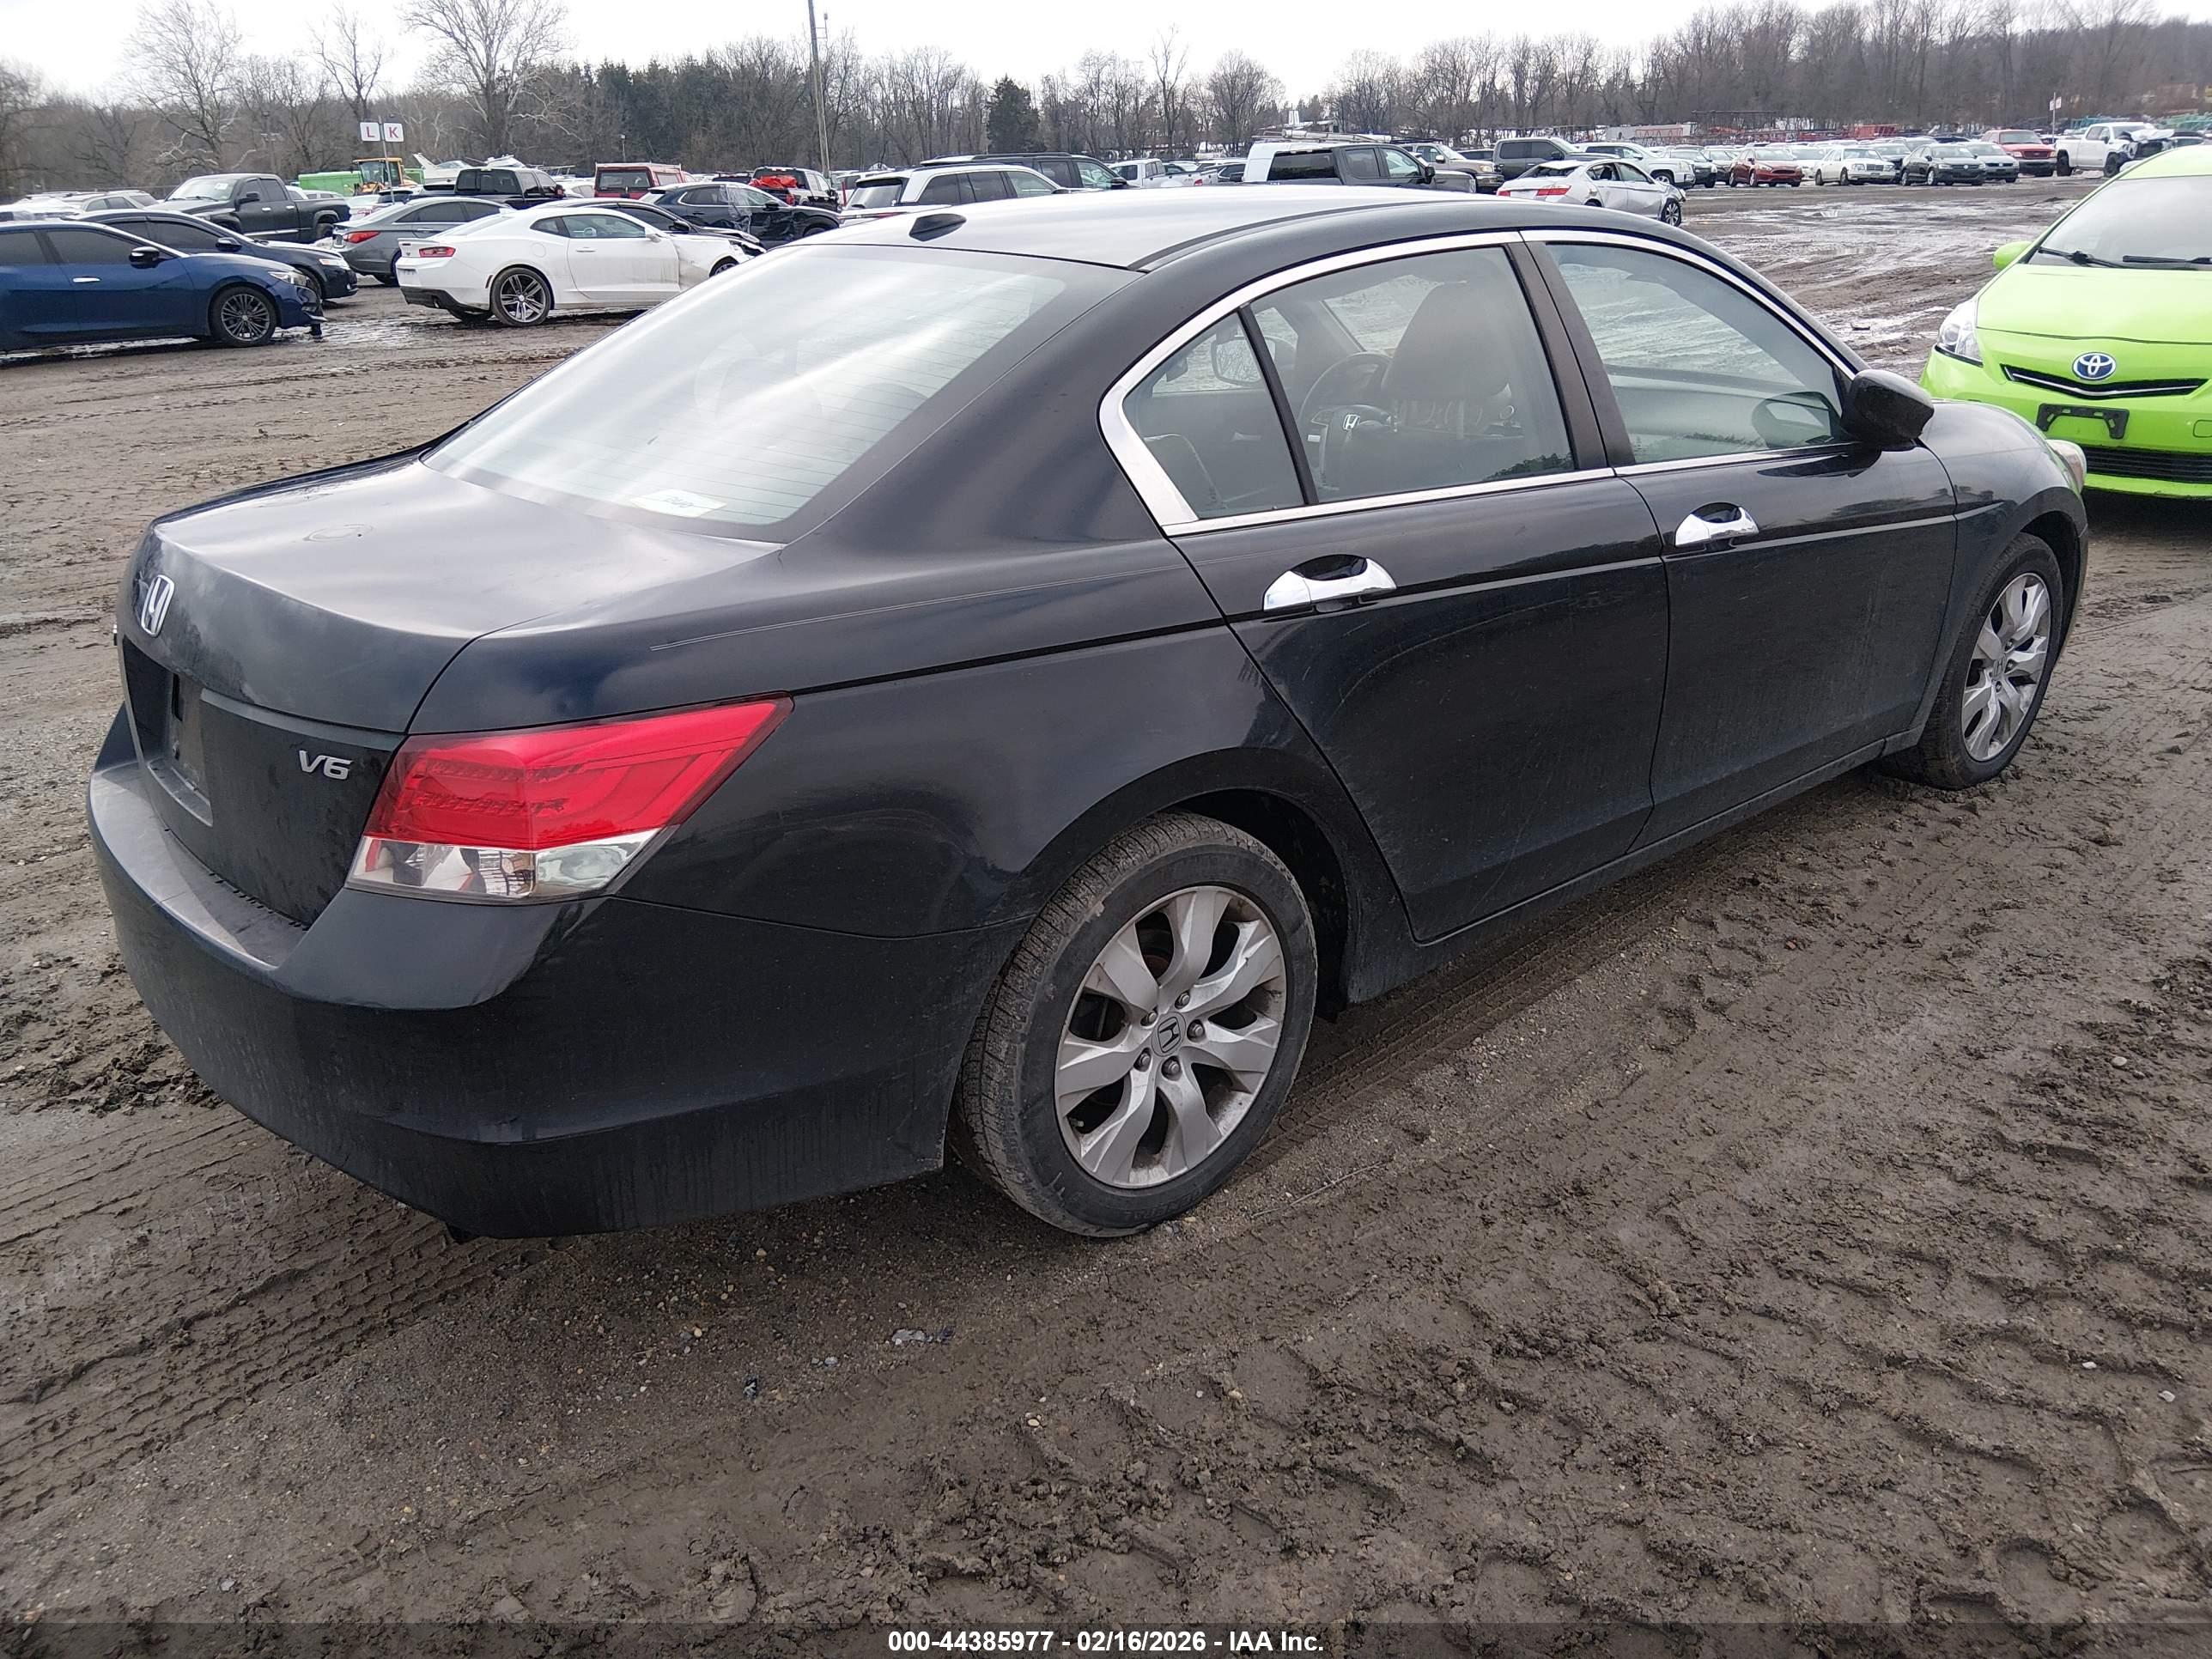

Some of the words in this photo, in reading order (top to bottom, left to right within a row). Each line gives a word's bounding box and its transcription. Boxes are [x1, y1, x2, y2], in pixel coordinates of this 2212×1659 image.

[366, 126, 375, 138] L
[388, 126, 399, 139] K
[299, 750, 354, 780] V6
